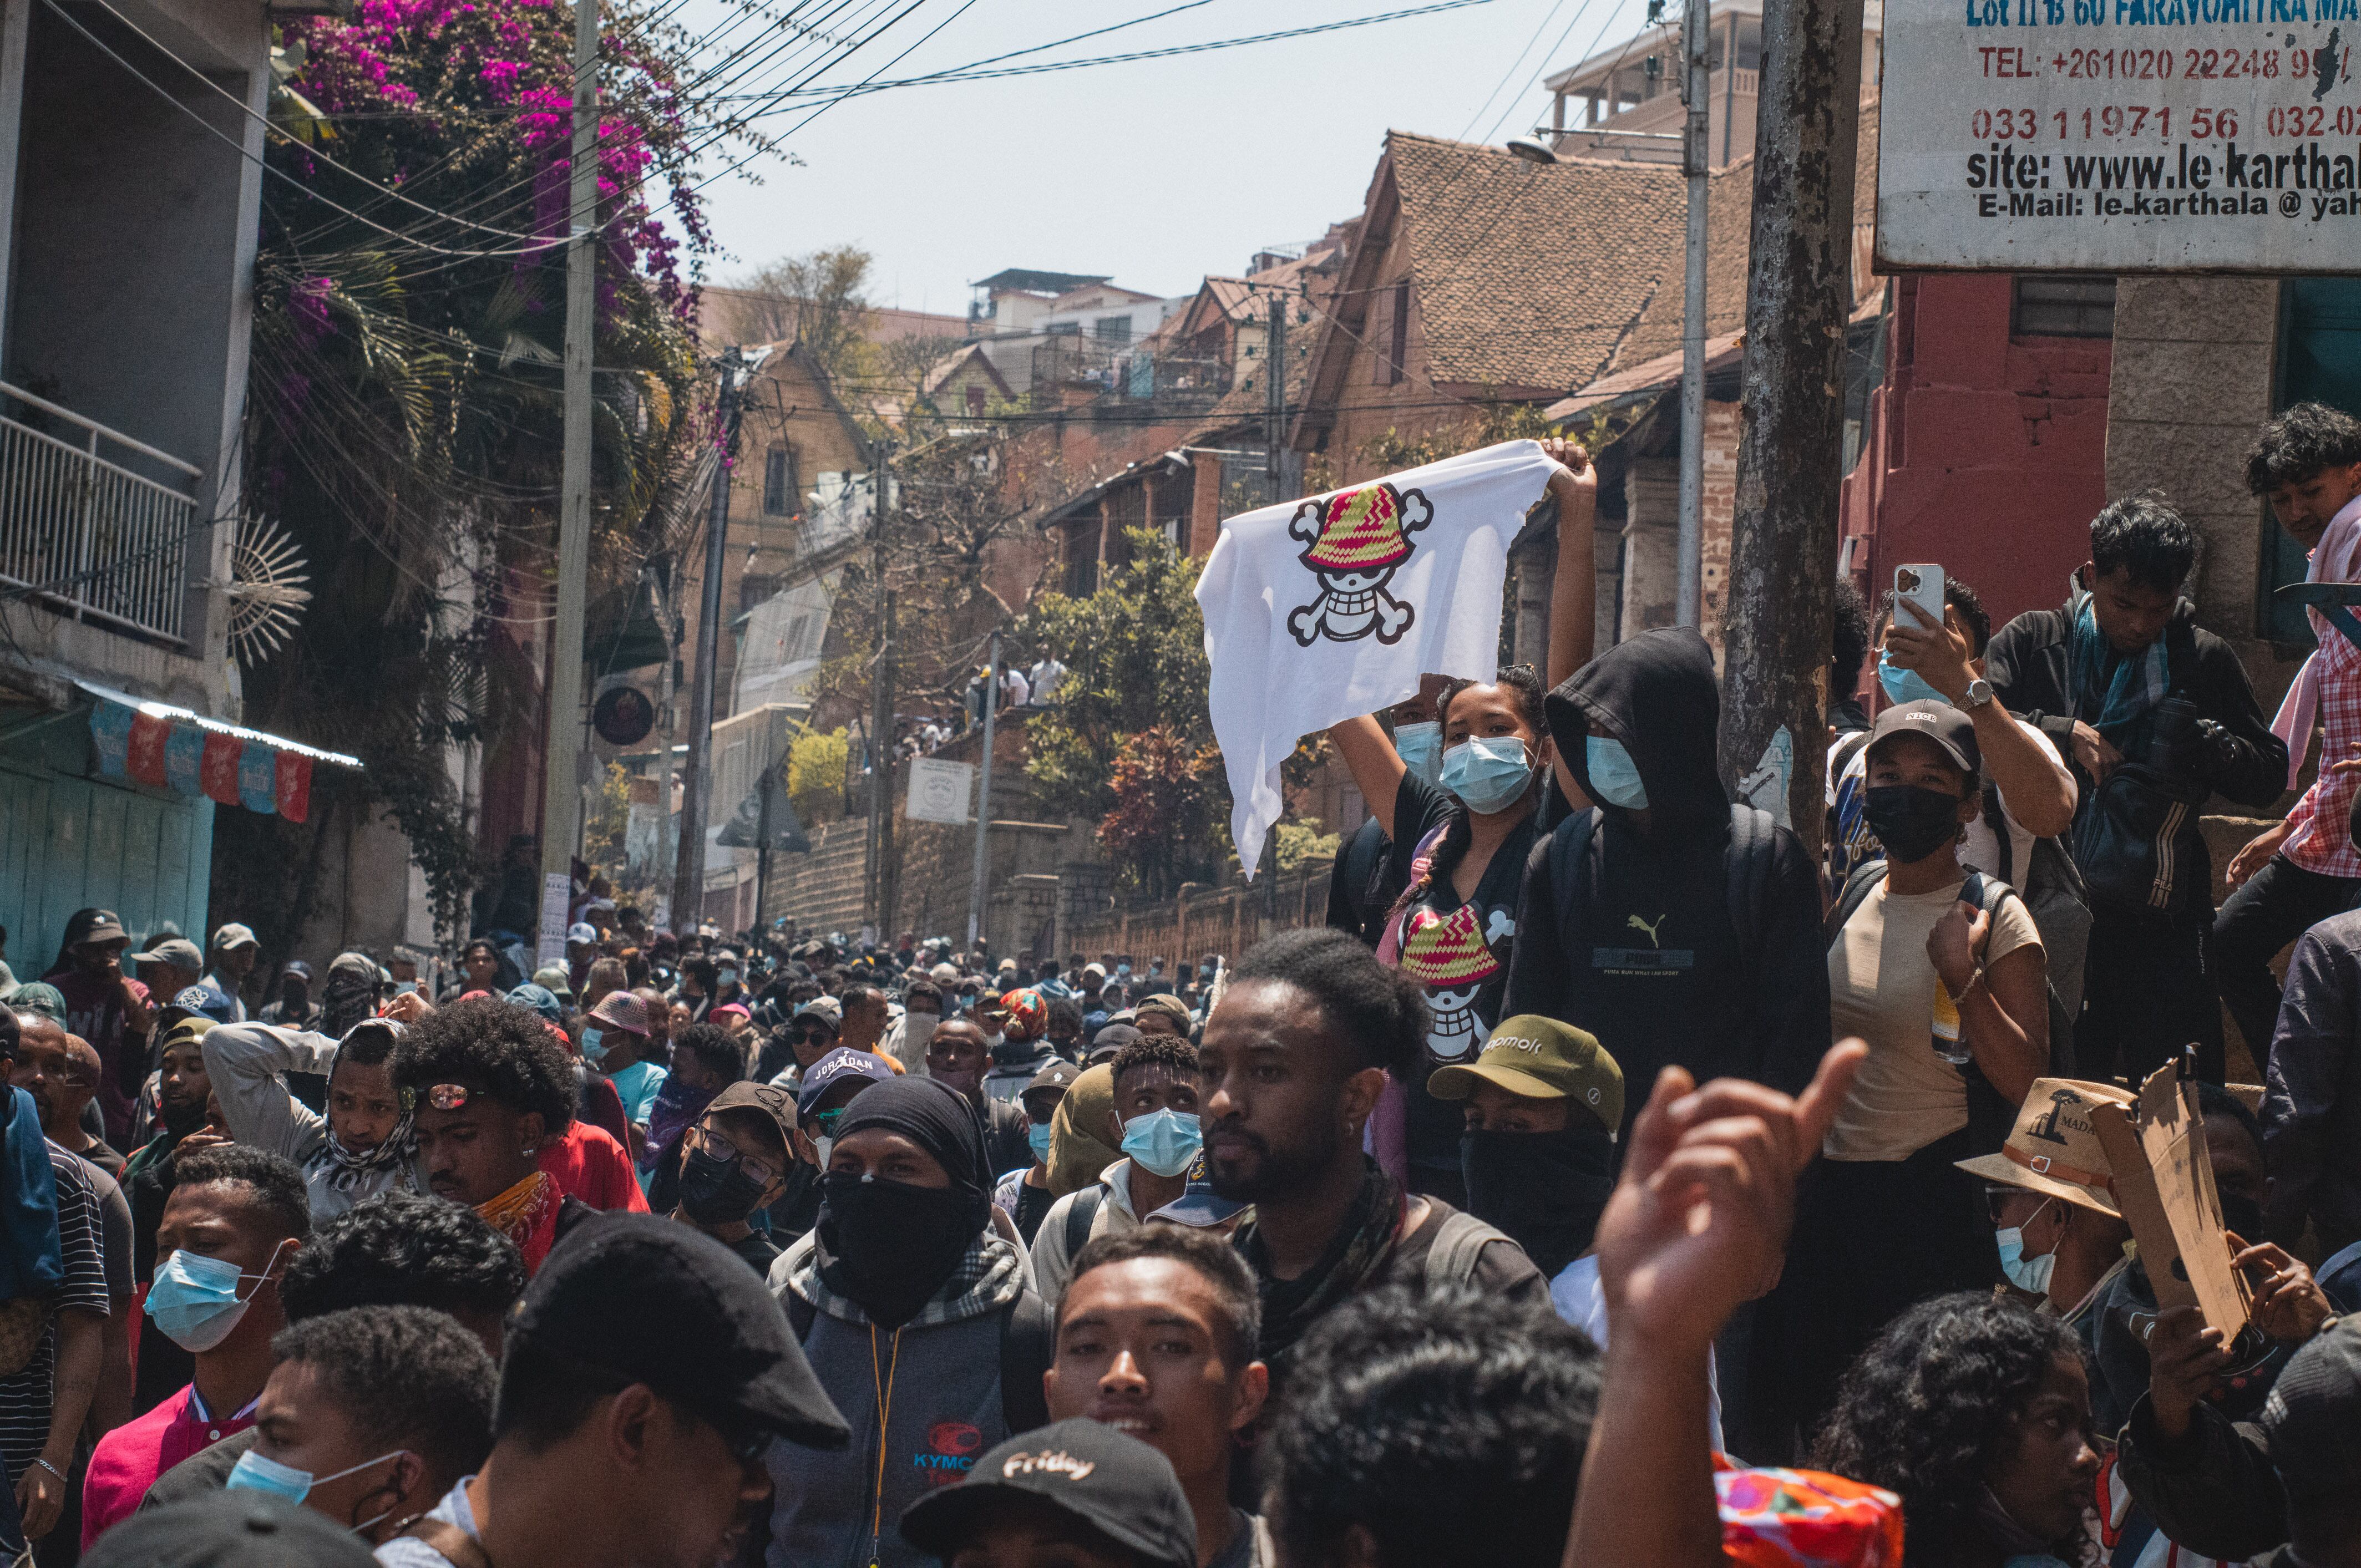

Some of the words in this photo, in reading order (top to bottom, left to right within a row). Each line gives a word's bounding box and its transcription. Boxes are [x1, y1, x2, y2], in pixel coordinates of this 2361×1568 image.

[1978, 47, 2041, 78] TEL:
[1972, 108, 2037, 139] 033
[2191, 108, 2238, 139] 56
[2267, 105, 2324, 138] 032
[1966, 142, 2050, 189] site:
[1979, 192, 2083, 217] E-Mail:
[2278, 190, 2301, 219] @
[1908, 713, 1936, 722] NICE
[2153, 878, 2173, 892] FILA
[814, 1057, 874, 1080] JORDAN
